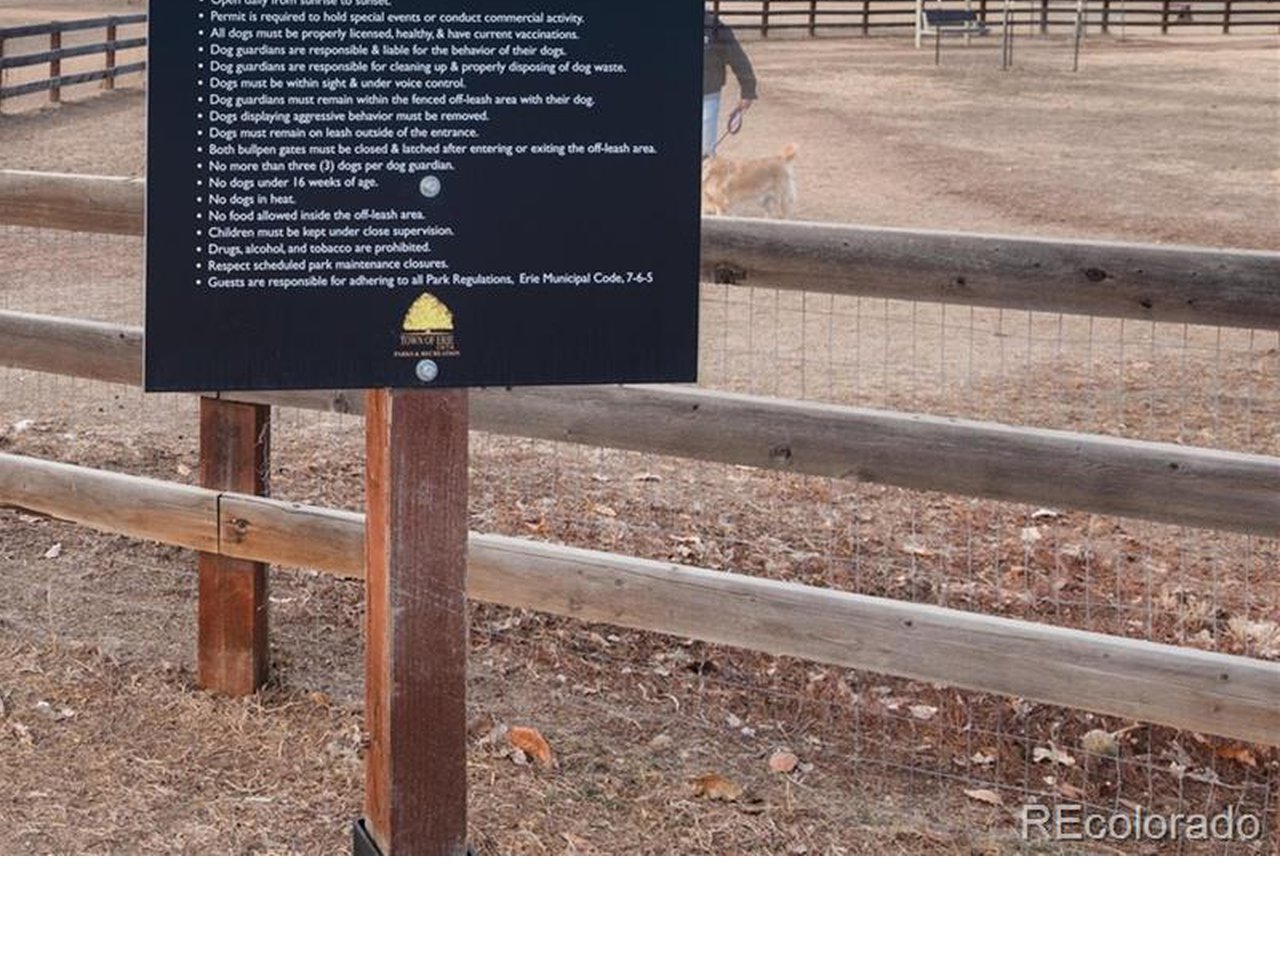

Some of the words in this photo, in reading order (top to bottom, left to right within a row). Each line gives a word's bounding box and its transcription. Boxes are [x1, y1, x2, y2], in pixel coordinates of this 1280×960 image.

[210, 10, 247, 22] Permit
[248, 13, 258, 22] is
[260, 11, 306, 25] required
[307, 13, 321, 23] to
[322, 11, 348, 23] hold
[349, 11, 385, 25] special
[386, 13, 422, 23] events
[423, 14, 437, 23] or
[438, 12, 482, 23] conduct
[483, 12, 545, 24] commercial
[546, 14, 585, 26] activity.
[209, 27, 226, 38] All
[227, 27, 254, 42] dogs
[255, 29, 283, 39] must
[284, 27, 299, 39] be
[301, 27, 347, 42] properly
[435, 27, 446, 40] &
[447, 28, 472, 40] have
[473, 30, 513, 40] current
[514, 29, 580, 40] vaccinations.
[210, 43, 234, 58] Dog
[235, 44, 286, 58] guardians
[288, 46, 306, 56] are
[308, 44, 369, 58] responsible
[370, 43, 380, 56] &
[382, 44, 410, 56] liable
[411, 43, 429, 56] for
[430, 44, 449, 56] the
[450, 44, 497, 56] behavior
[497, 44, 511, 56] of
[512, 44, 538, 56] their
[539, 44, 567, 59] dogs.
[209, 60, 234, 75] Dog
[235, 60, 286, 75] guardians
[288, 63, 306, 72] are
[308, 60, 369, 75] responsible
[370, 60, 388, 73] for
[388, 60, 432, 75] cleaning
[433, 63, 448, 75] up
[449, 60, 459, 73] &
[461, 60, 507, 75] properly
[508, 60, 557, 75] disposing
[557, 60, 571, 73] of
[571, 61, 592, 76] dog
[593, 63, 627, 73] waste.
[209, 76, 239, 92] Dogs
[240, 79, 268, 89] must
[269, 77, 284, 89] be
[285, 77, 320, 89] within
[321, 77, 347, 92] sight
[348, 77, 359, 89] &
[360, 77, 393, 89] under
[394, 78, 423, 89] voice
[424, 77, 467, 89] control.
[209, 93, 234, 109] Dog
[234, 93, 286, 108] guardians
[287, 96, 315, 105] must
[316, 94, 354, 105] remain
[355, 93, 389, 105] within
[391, 93, 410, 105] the
[411, 93, 447, 105] fenced
[448, 93, 493, 105] off-leash
[494, 96, 518, 105] area
[519, 93, 544, 105] with
[545, 93, 571, 105] their
[572, 93, 595, 108] dog.
[209, 109, 238, 125] Dogs
[240, 110, 291, 125] displaying
[292, 110, 346, 125] aggressive
[347, 110, 394, 122] behavior
[395, 112, 423, 122] must
[424, 110, 439, 122] be
[440, 110, 489, 122] removed.
[208, 160, 228, 172] No
[229, 162, 259, 172] more
[261, 160, 286, 172] than
[287, 159, 317, 171] three
[319, 158, 335, 174] (3)
[336, 159, 363, 174] dogs
[364, 162, 384, 174] per
[385, 159, 407, 174] dog
[407, 159, 455, 174] guardian.
[208, 177, 228, 189] No
[229, 176, 255, 191] dogs
[256, 176, 290, 188] under
[293, 176, 306, 188] 16
[307, 176, 342, 188] weeks
[343, 175, 357, 188] of
[357, 178, 379, 191] age.
[208, 193, 228, 205] No
[229, 193, 255, 208] dogs
[257, 193, 268, 205] in
[269, 193, 296, 205] heat.
[208, 209, 227, 222] No
[228, 209, 255, 222] food
[256, 209, 298, 222] allowed
[300, 209, 332, 221] inside
[333, 209, 352, 221] the
[353, 208, 399, 221] off-leash
[399, 210, 426, 220] area.
[287, 242, 308, 254] and
[309, 242, 353, 254] tobacco
[354, 244, 373, 253] are
[374, 241, 432, 256] prohibited.
[207, 259, 251, 274] Respect
[253, 259, 307, 271] scheduled
[308, 258, 333, 273] park
[334, 259, 401, 270] maintenance
[402, 257, 449, 270] closures.
[207, 276, 246, 288] Guests
[247, 278, 266, 288] are
[267, 275, 329, 290] responsible
[330, 274, 347, 287] for
[348, 274, 395, 289] adhering
[396, 276, 410, 286] to
[411, 274, 424, 286] all
[425, 273, 451, 285] Park
[519, 272, 541, 285] Erie
[542, 272, 592, 286] Municipal
[626, 271, 654, 284] 7-6-5
